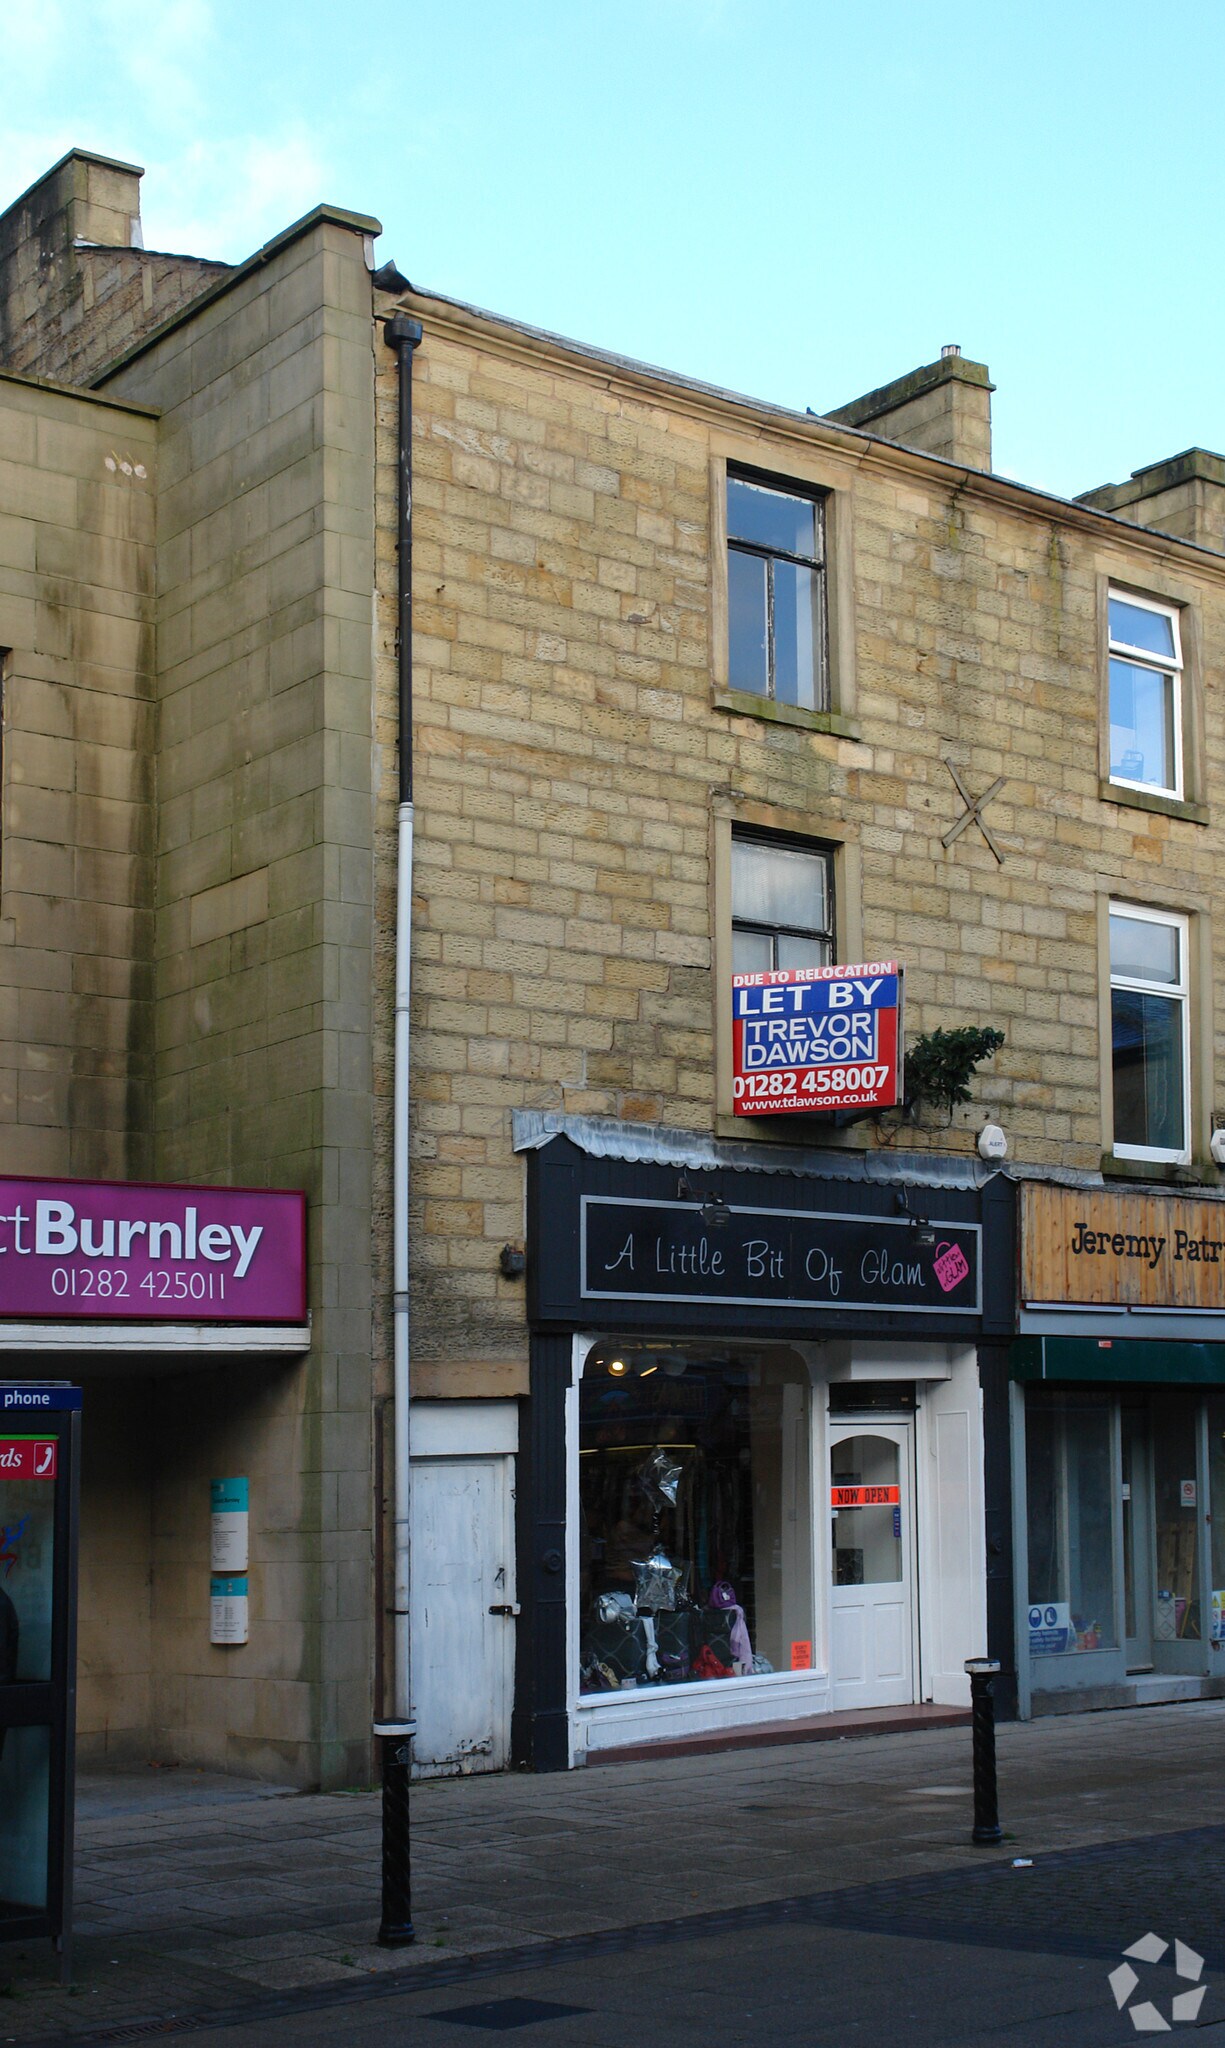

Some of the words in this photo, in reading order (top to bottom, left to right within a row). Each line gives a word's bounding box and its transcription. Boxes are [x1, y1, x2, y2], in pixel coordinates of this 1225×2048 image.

[733, 975, 763, 987] DUE
[769, 971, 789, 984] TO
[795, 962, 892, 981] RELOCATION
[739, 985, 811, 1016] LET
[828, 979, 884, 1009] BY
[747, 1012, 872, 1043] TREVOR
[747, 1035, 873, 1067] DAWSON
[733, 1072, 797, 1098] 01282
[801, 1066, 890, 1093] 458007
[742, 1090, 878, 1111] www.tdawson.co.uk
[1072, 1223, 1166, 1269] Jeremy
[1174, 1230, 1225, 1263] Patr
[605, 1233, 635, 1270] A
[656, 1237, 726, 1275] Little
[742, 1240, 785, 1278] Bit
[806, 1248, 843, 1296] Of
[861, 1249, 926, 1287] Glam
[52, 1268, 130, 1297] 01282
[140, 1271, 225, 1300] 425011
[4, 1390, 50, 1408] phone
[837, 1489, 859, 1504] NOW
[865, 1488, 889, 1503] OPEN
